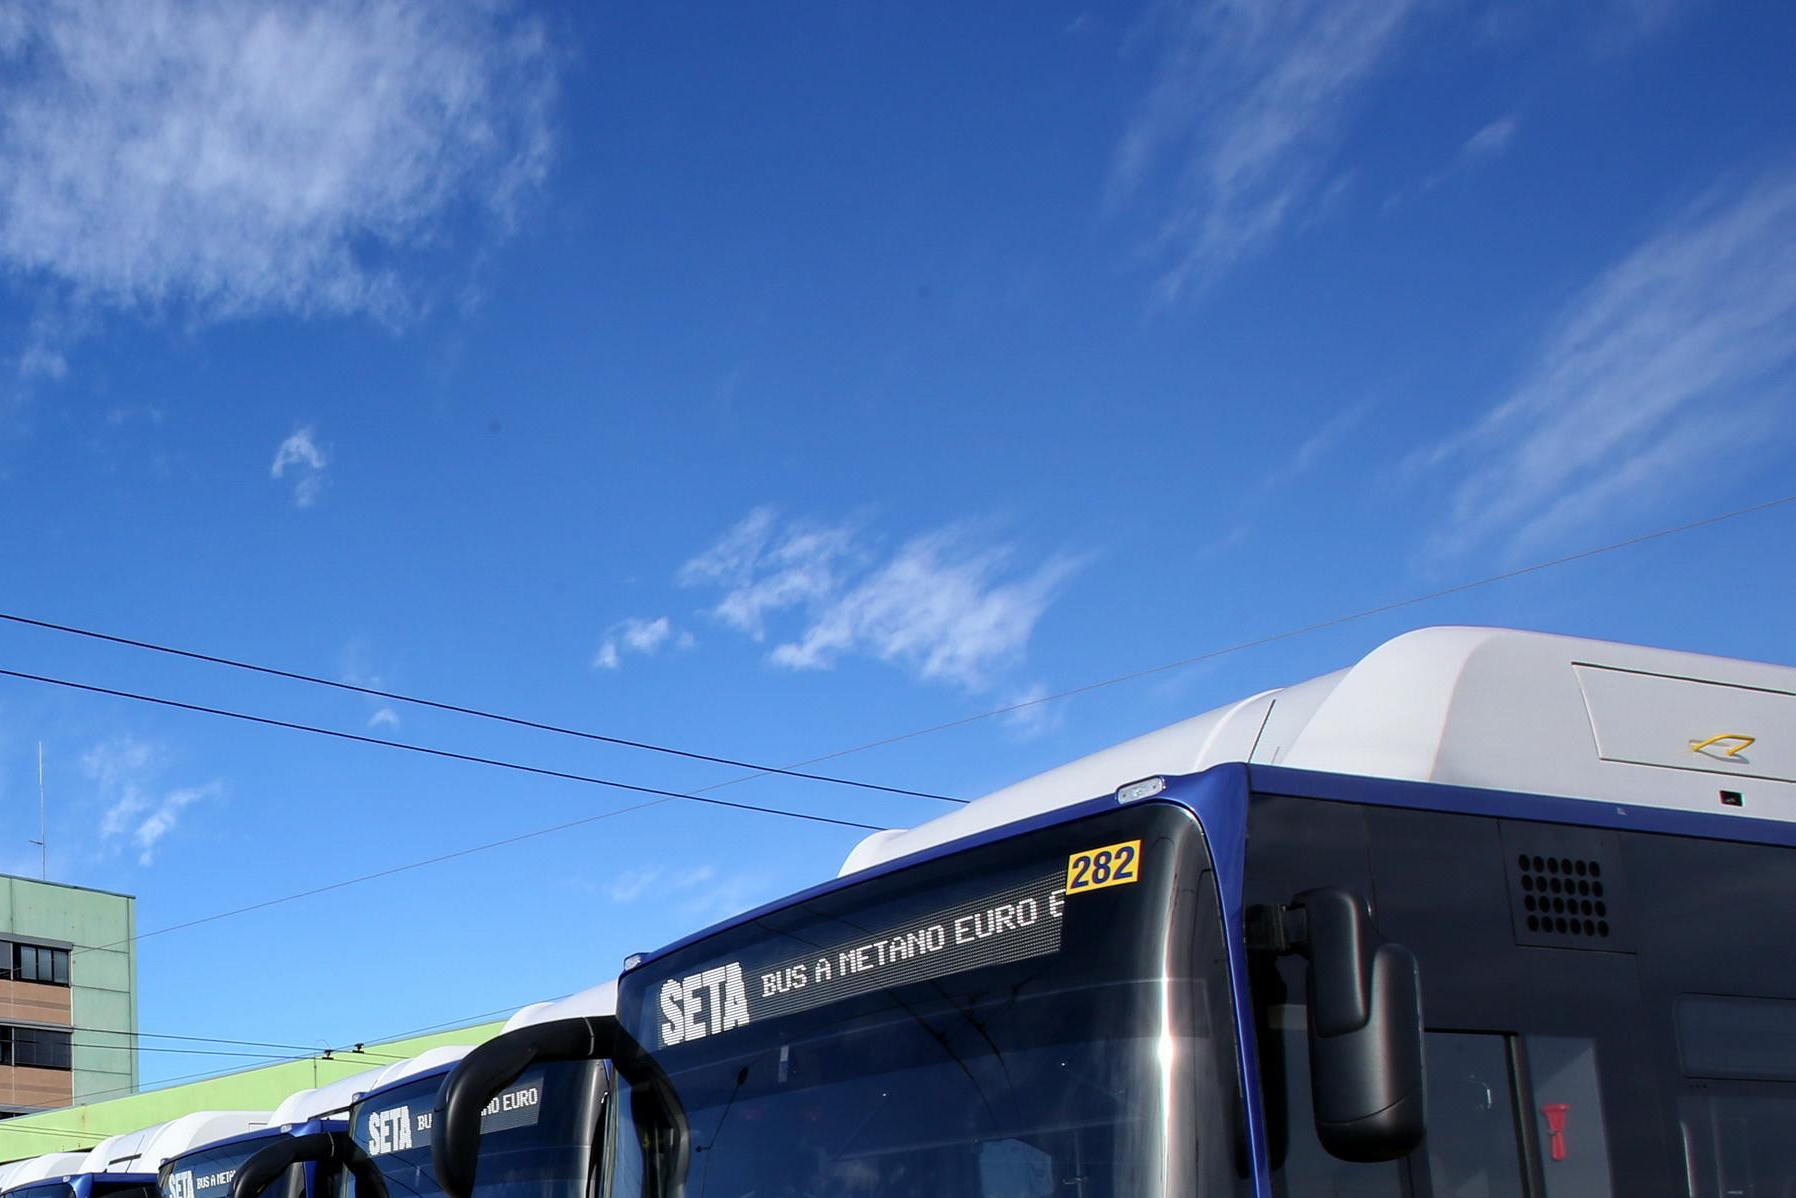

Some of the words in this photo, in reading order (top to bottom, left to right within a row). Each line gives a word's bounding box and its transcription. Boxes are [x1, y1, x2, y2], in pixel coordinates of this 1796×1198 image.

[1070, 846, 1134, 889] 282
[660, 962, 749, 1046] SETA
[761, 964, 807, 997] BUS
[815, 958, 831, 983] A
[839, 925, 945, 976] METANO
[954, 898, 1037, 944] EURO
[503, 1087, 537, 1111] EURO
[368, 1105, 412, 1156] SETA
[417, 1113, 432, 1131] BU
